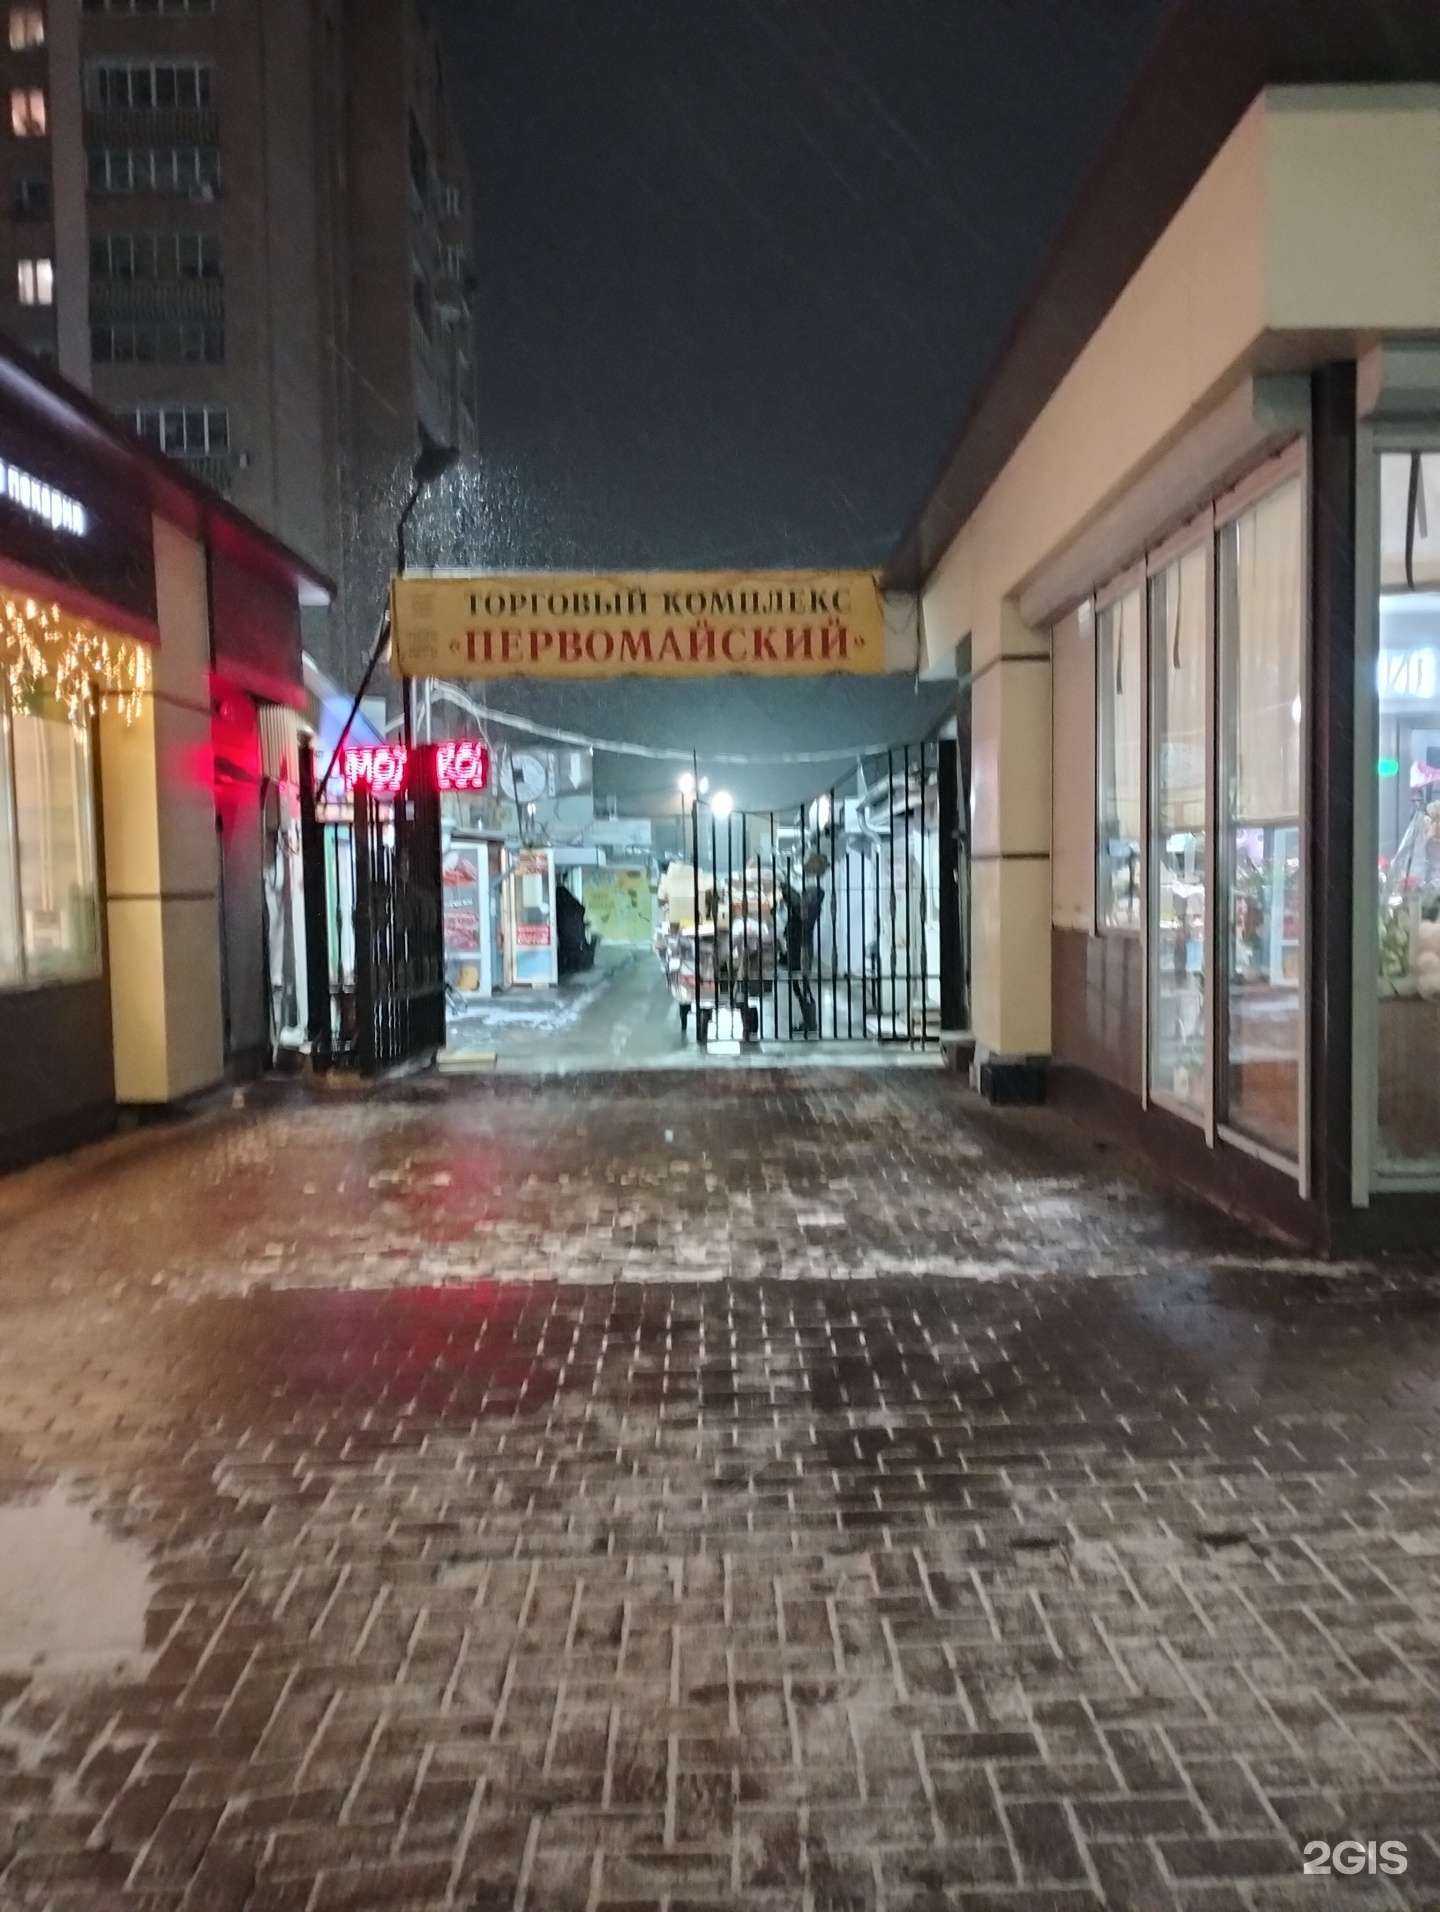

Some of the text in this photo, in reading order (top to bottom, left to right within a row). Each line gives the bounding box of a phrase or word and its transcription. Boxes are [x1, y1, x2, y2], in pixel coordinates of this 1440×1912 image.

[467, 587, 851, 616] ТОРГОВЫЙ КОМПЛЕКС
[449, 617, 866, 663] «ПЕРВОМАЙСКИЙ»
